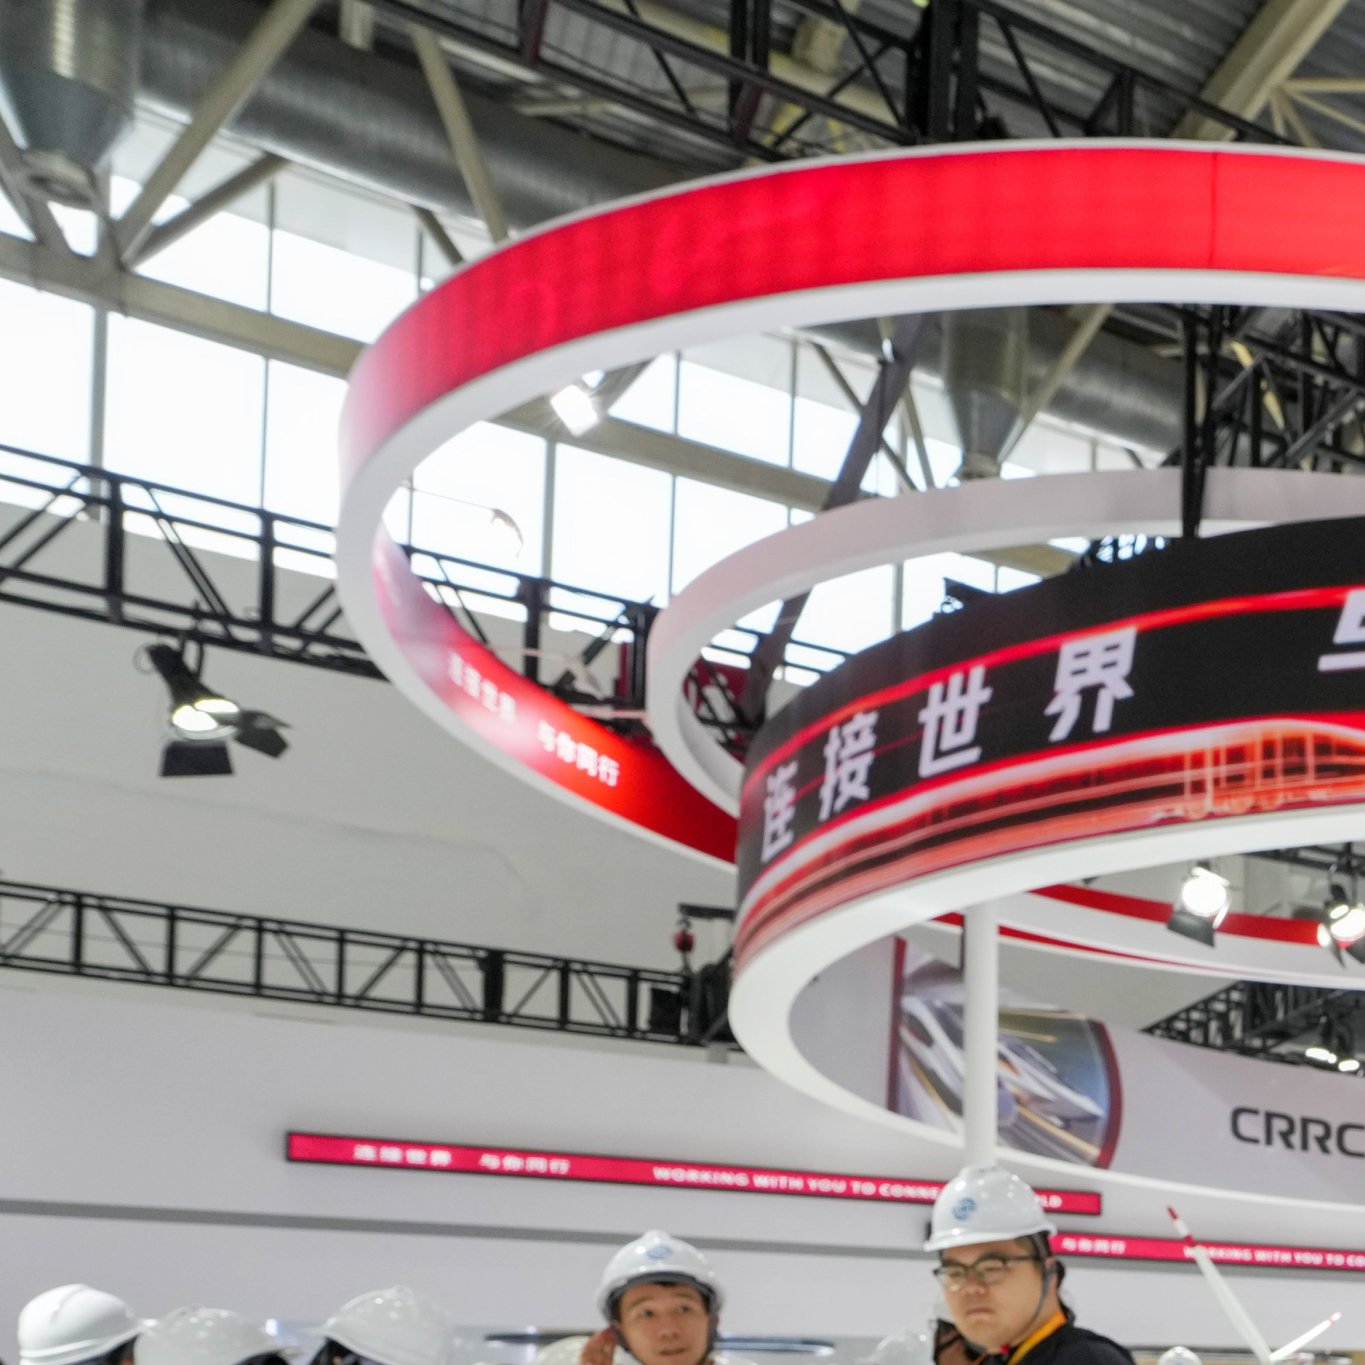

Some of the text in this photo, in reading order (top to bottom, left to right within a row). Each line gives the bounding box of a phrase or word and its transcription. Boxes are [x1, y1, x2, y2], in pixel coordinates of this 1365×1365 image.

[761, 625, 1138, 863] 连接世界
[653, 1165, 749, 1187] WORKING
[753, 1171, 803, 1191] WITH
[806, 1174, 847, 1195] YOU
[851, 1177, 877, 1197] TO
[1255, 1249, 1292, 1264] WITH
[1294, 1251, 1323, 1266] YOU
[1325, 1253, 1345, 1267] TO
